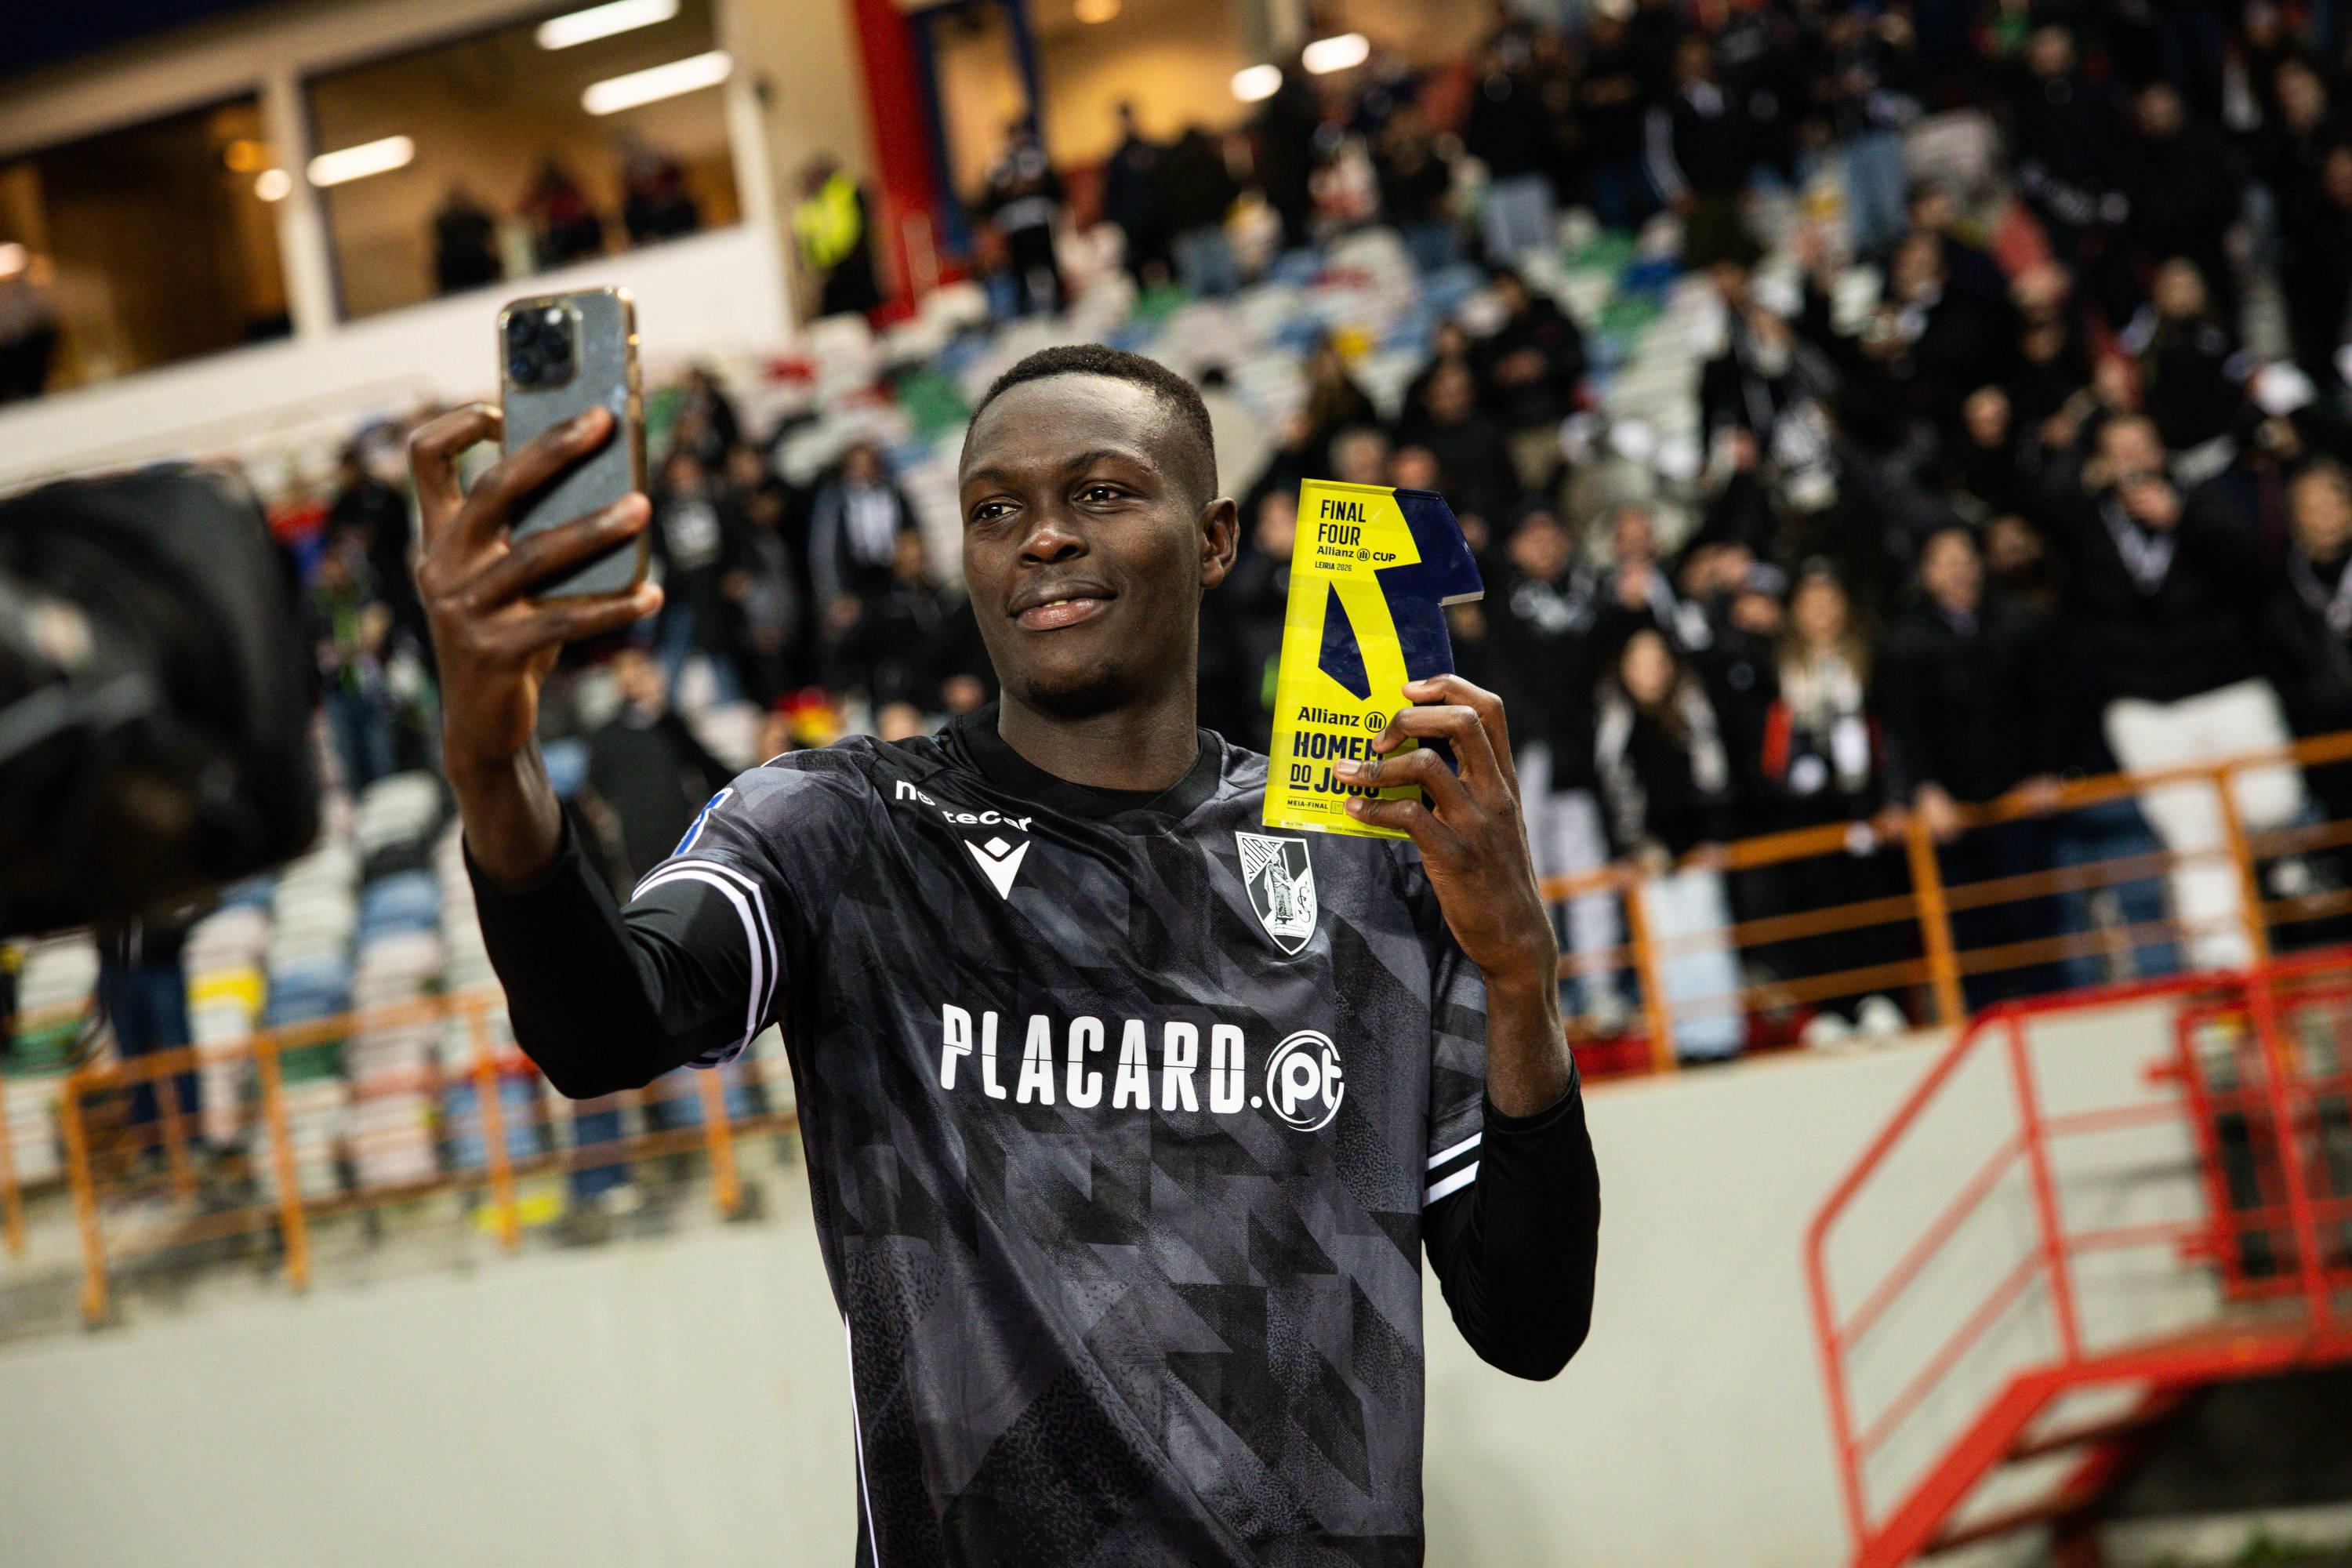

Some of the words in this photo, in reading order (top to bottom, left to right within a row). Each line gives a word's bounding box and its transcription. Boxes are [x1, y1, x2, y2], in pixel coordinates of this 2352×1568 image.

[1320, 499, 1367, 523] FINAL
[1317, 523, 1361, 546] FOUR
[1316, 545, 1355, 558] Allianz
[1373, 551, 1396, 562] CUP
[1315, 561, 1335, 571] LEIRIA
[1336, 563, 1352, 572] 2026
[1298, 706, 1360, 728] Allianz
[1290, 763, 1312, 784] DO
[1287, 799, 1329, 810] MEIA-FINAL
[940, 1002, 1345, 1132] PLACARD.pt
